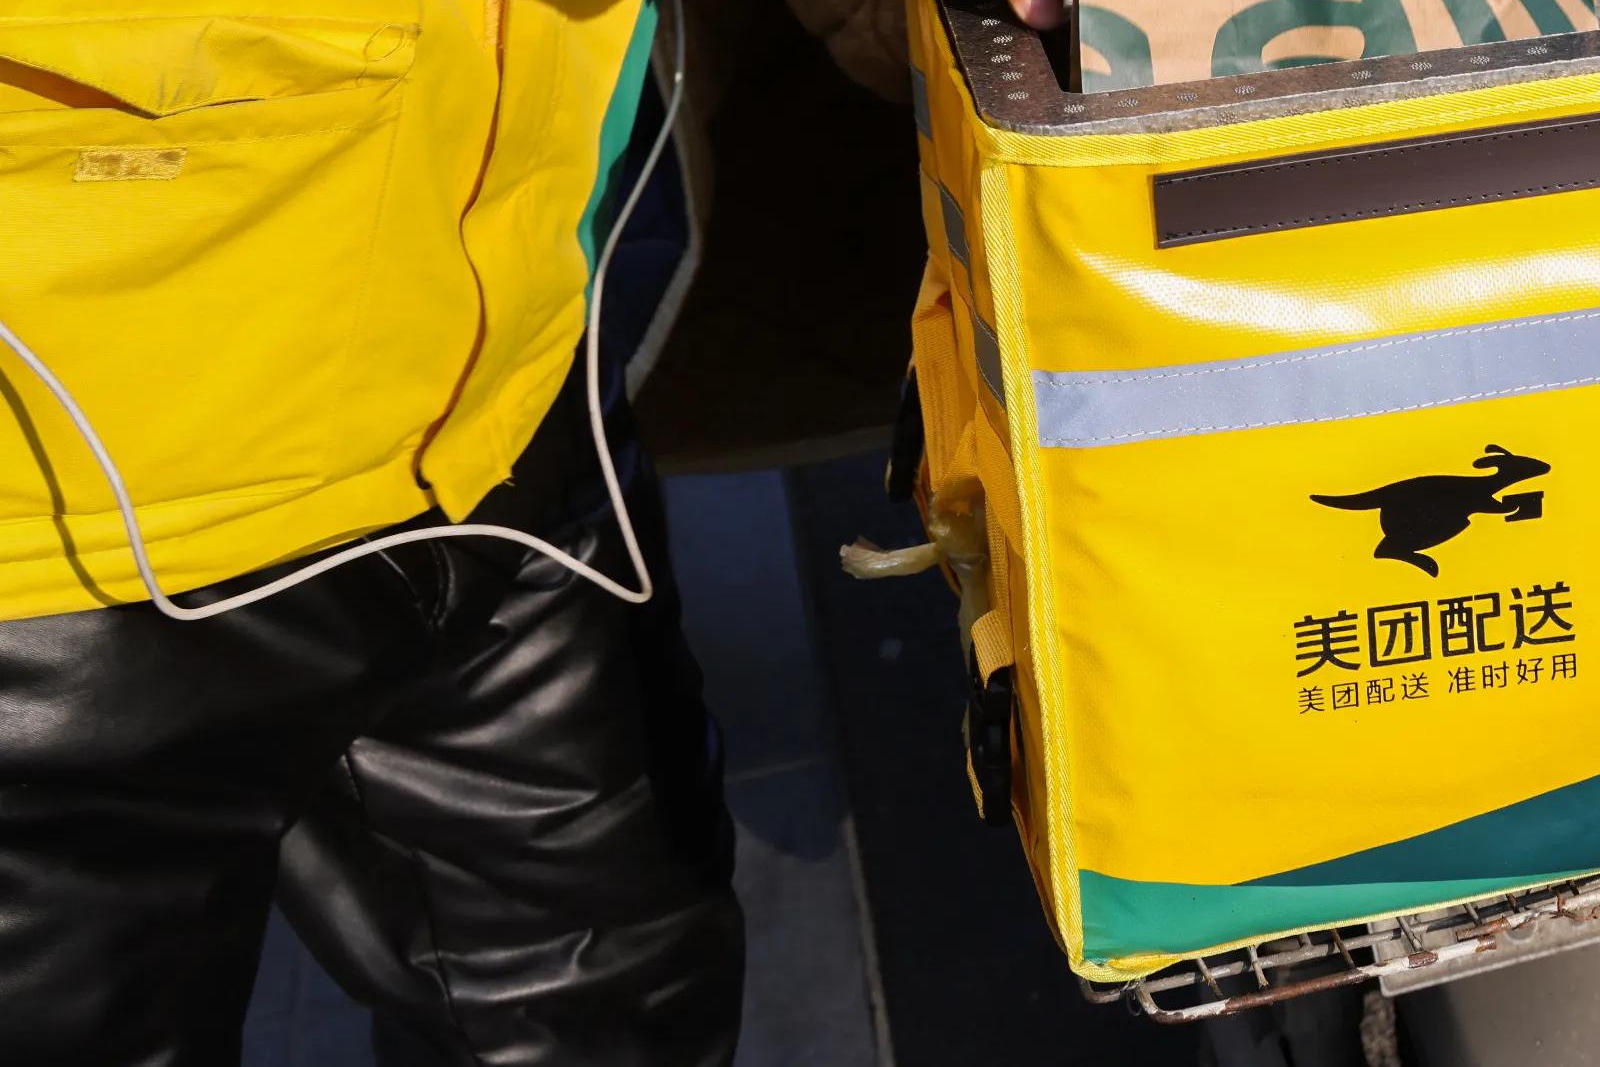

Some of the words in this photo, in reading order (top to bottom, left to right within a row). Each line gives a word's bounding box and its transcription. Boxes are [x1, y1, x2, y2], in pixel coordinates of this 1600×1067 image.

[1293, 581, 1577, 678] 美团配送
[1298, 672, 1430, 715] 美团配送
[1447, 653, 1578, 695] 准时好用
